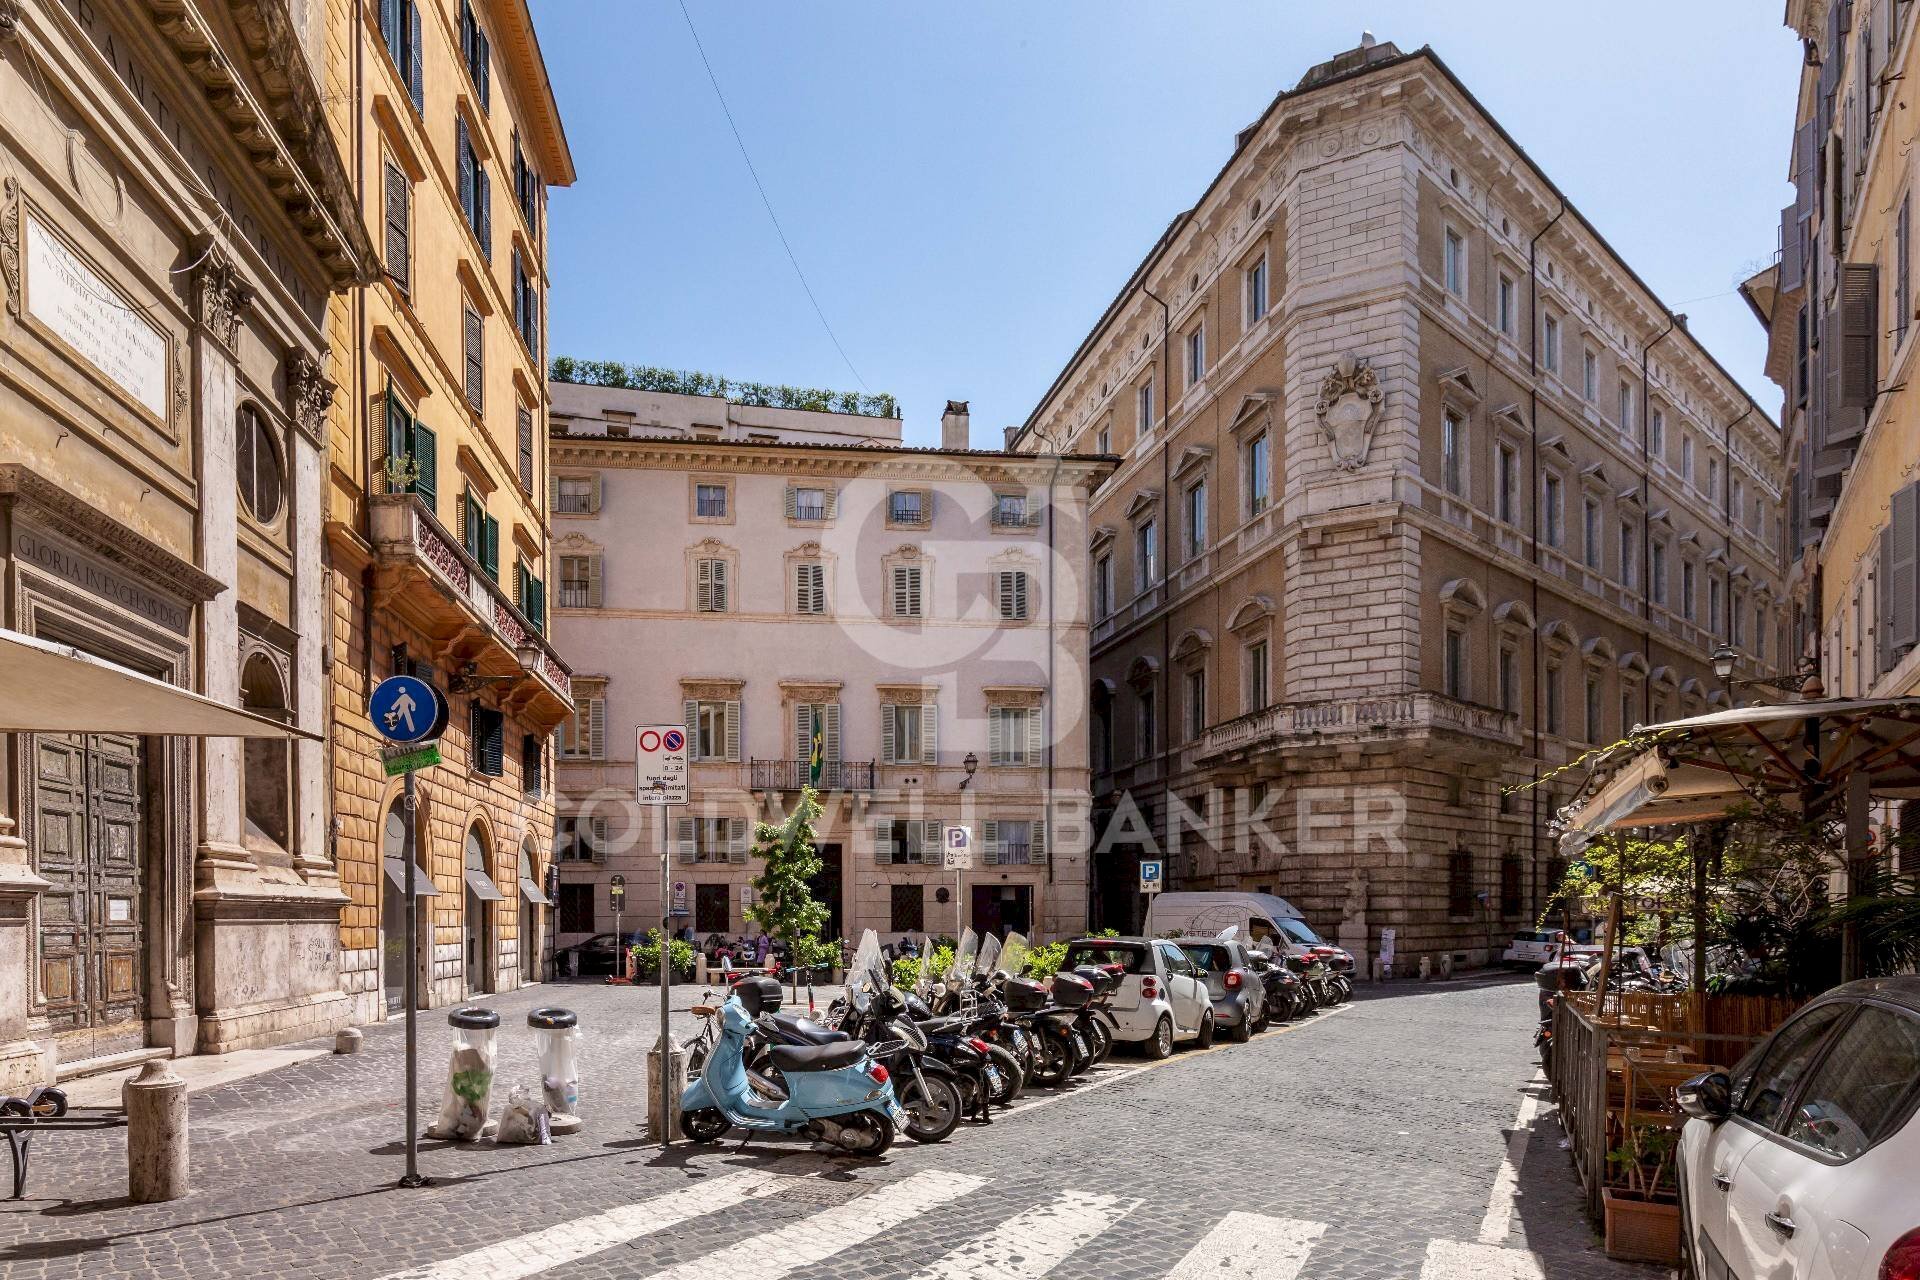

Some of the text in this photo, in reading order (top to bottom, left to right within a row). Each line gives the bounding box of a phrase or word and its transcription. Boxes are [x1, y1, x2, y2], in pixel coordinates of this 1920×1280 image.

[18, 534, 183, 629] GLORIA IN EXCELSIS DEO
[951, 830, 964, 847] P
[1145, 865, 1156, 878] P
